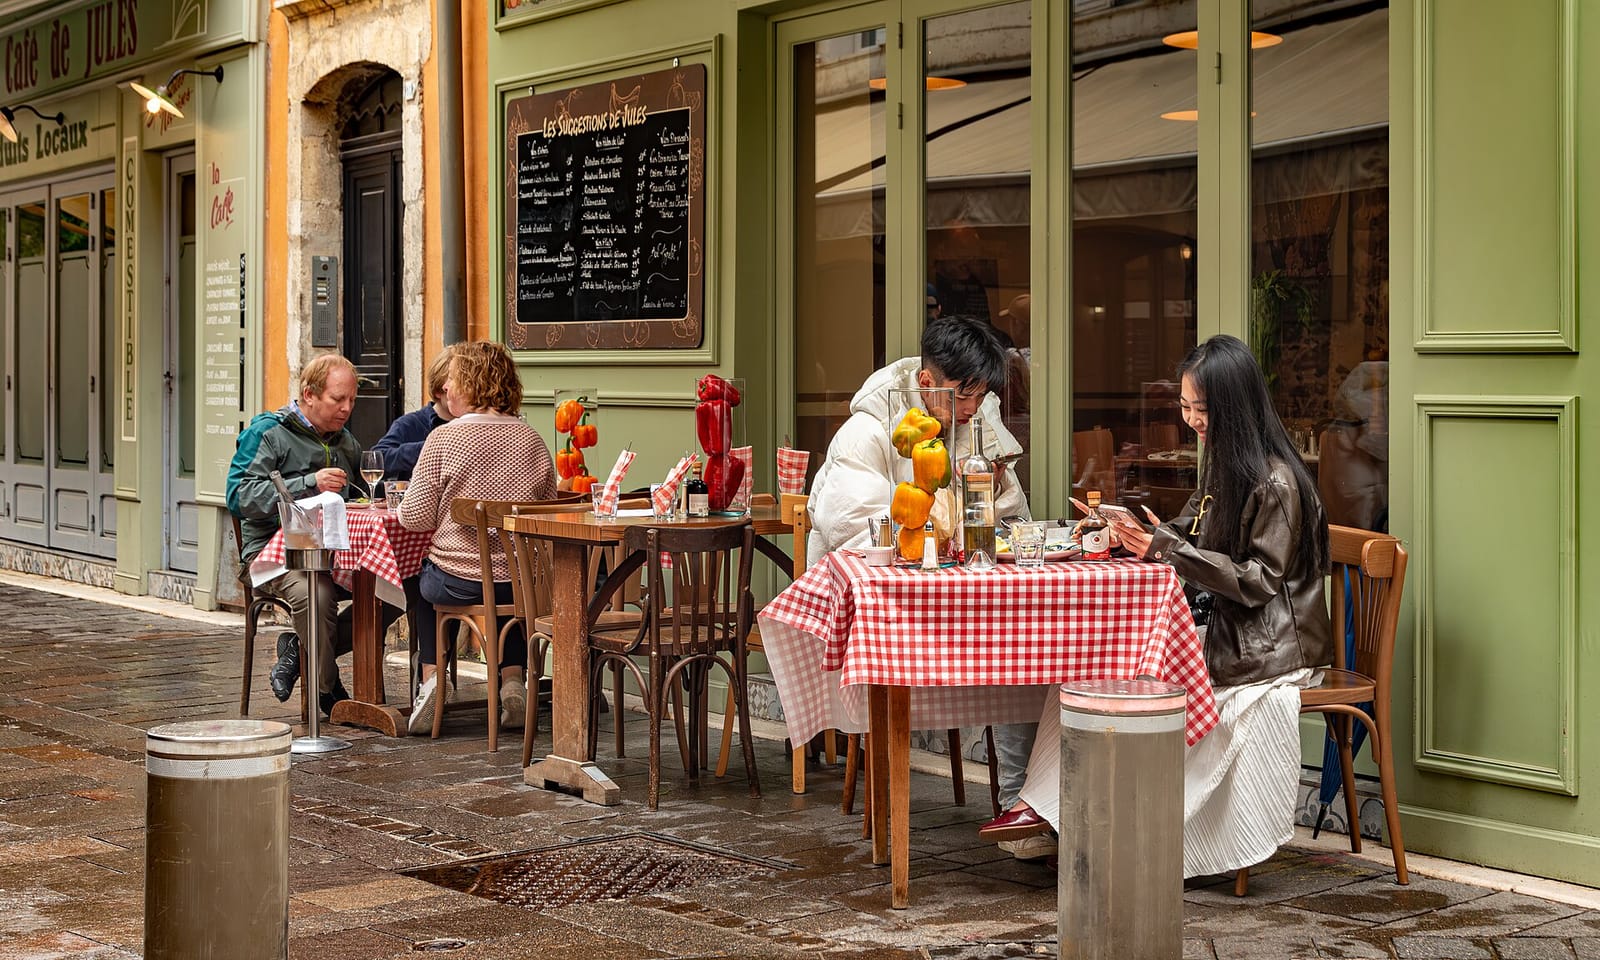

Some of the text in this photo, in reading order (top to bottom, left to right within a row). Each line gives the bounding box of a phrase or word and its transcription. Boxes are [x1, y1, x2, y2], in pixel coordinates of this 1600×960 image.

[6, 0, 138, 93] Café de JULES
[36, 120, 88, 159] Locaux
[212, 162, 220, 185] la
[211, 186, 234, 230] Carte
[125, 158, 135, 421] COMESTIBLE
